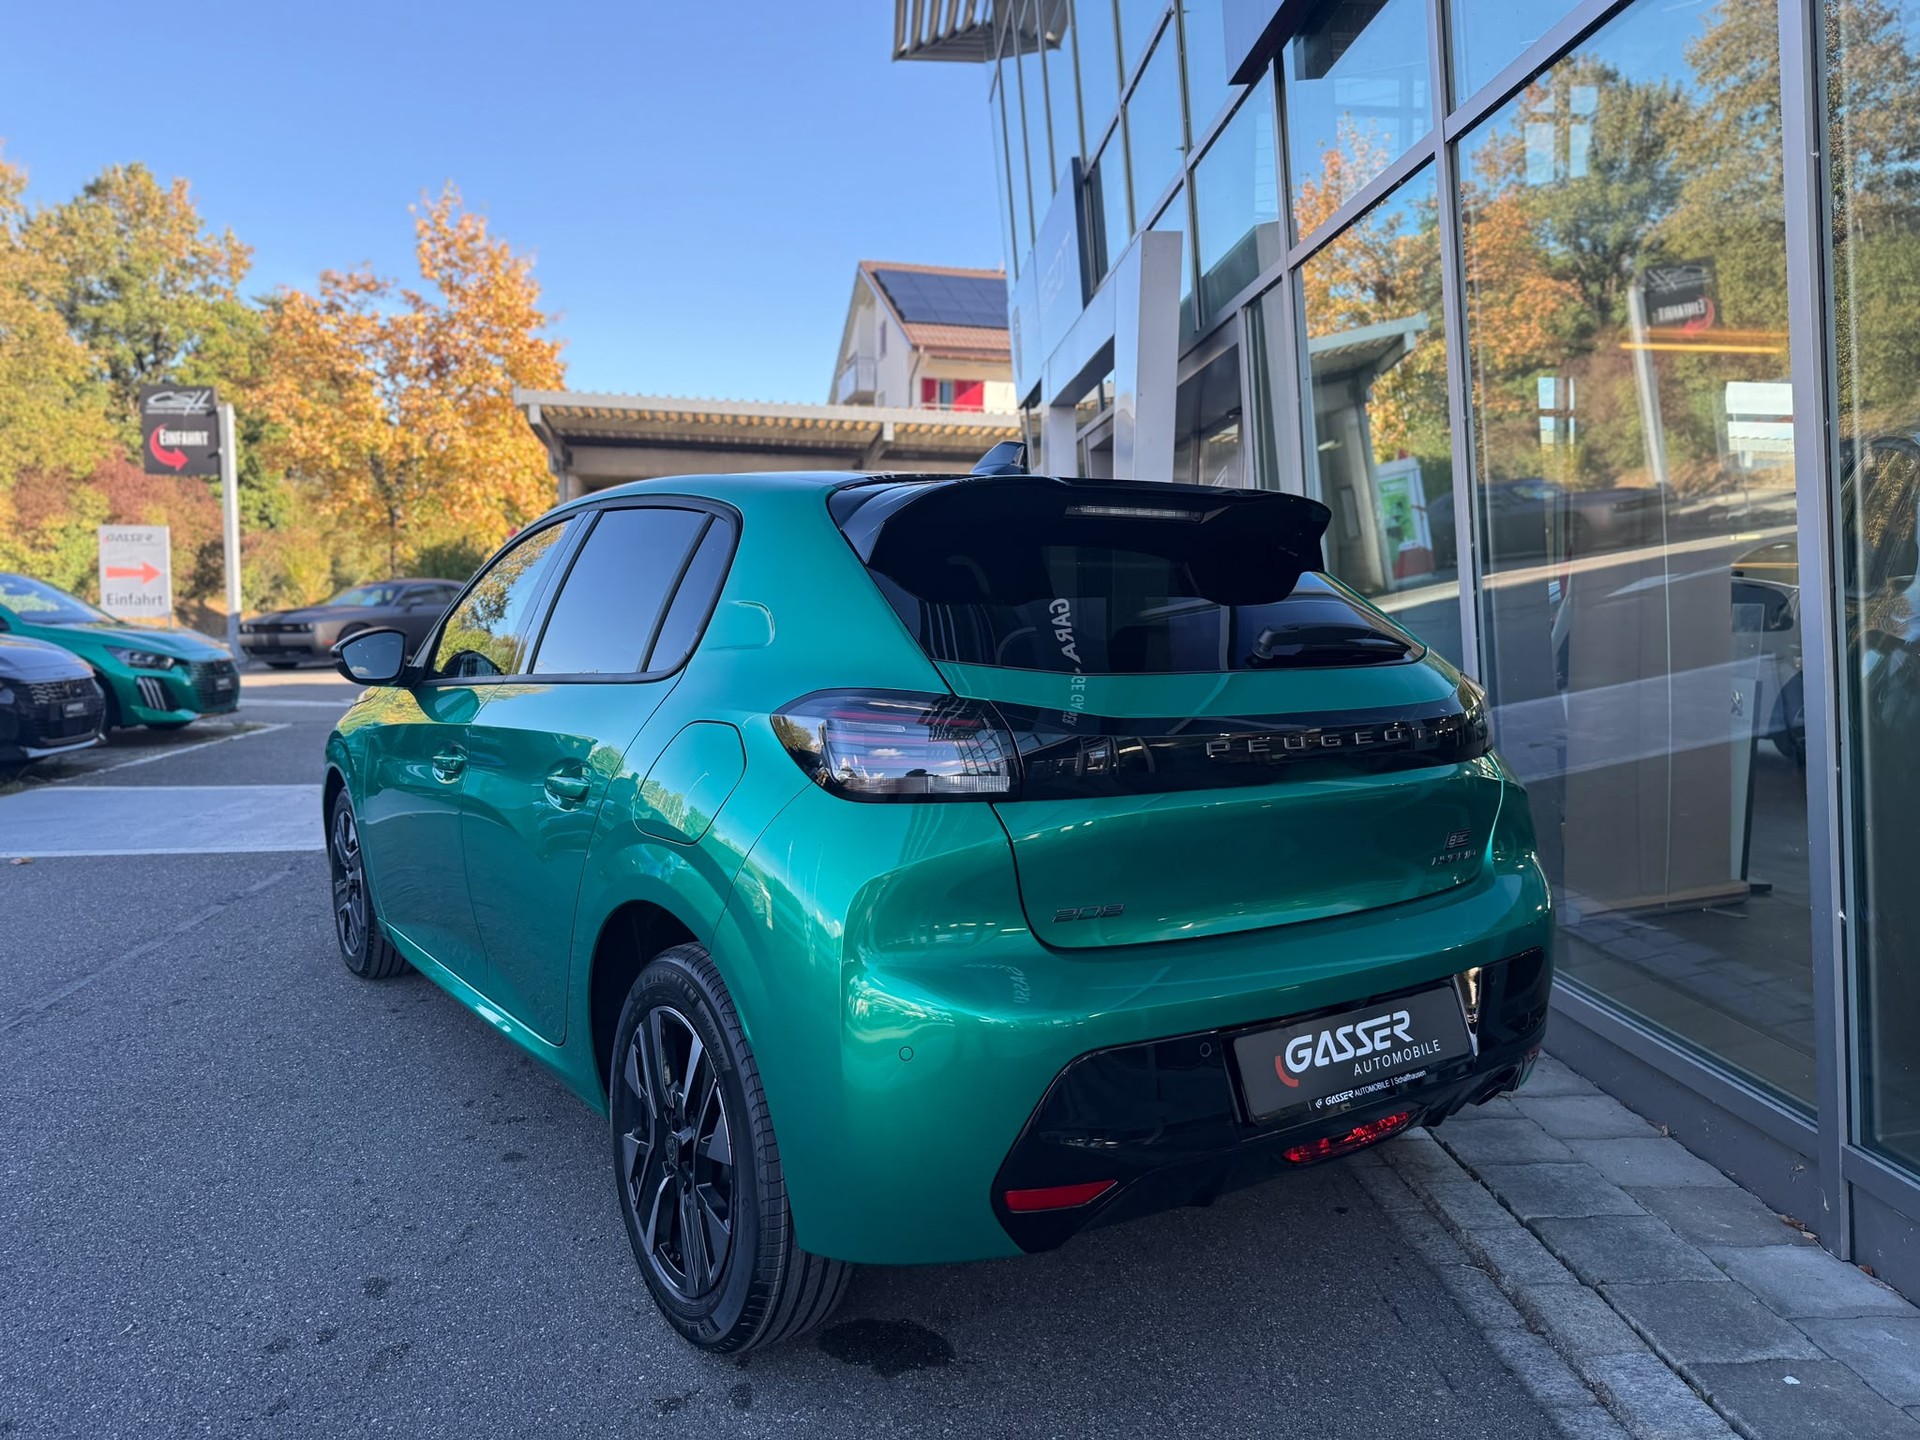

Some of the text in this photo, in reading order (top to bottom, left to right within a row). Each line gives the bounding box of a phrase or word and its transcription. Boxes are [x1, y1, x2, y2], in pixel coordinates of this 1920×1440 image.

[106, 593, 164, 606] Einfahrt
[1052, 903, 1124, 923] 208
[1285, 1010, 1414, 1073] GASSER
[1354, 1039, 1441, 1076] AUTOMOBILE
[1325, 1090, 1354, 1106] GASSER
[1354, 1080, 1390, 1097] AUTOMOBILE
[1394, 1070, 1427, 1085] Schaffhausen
